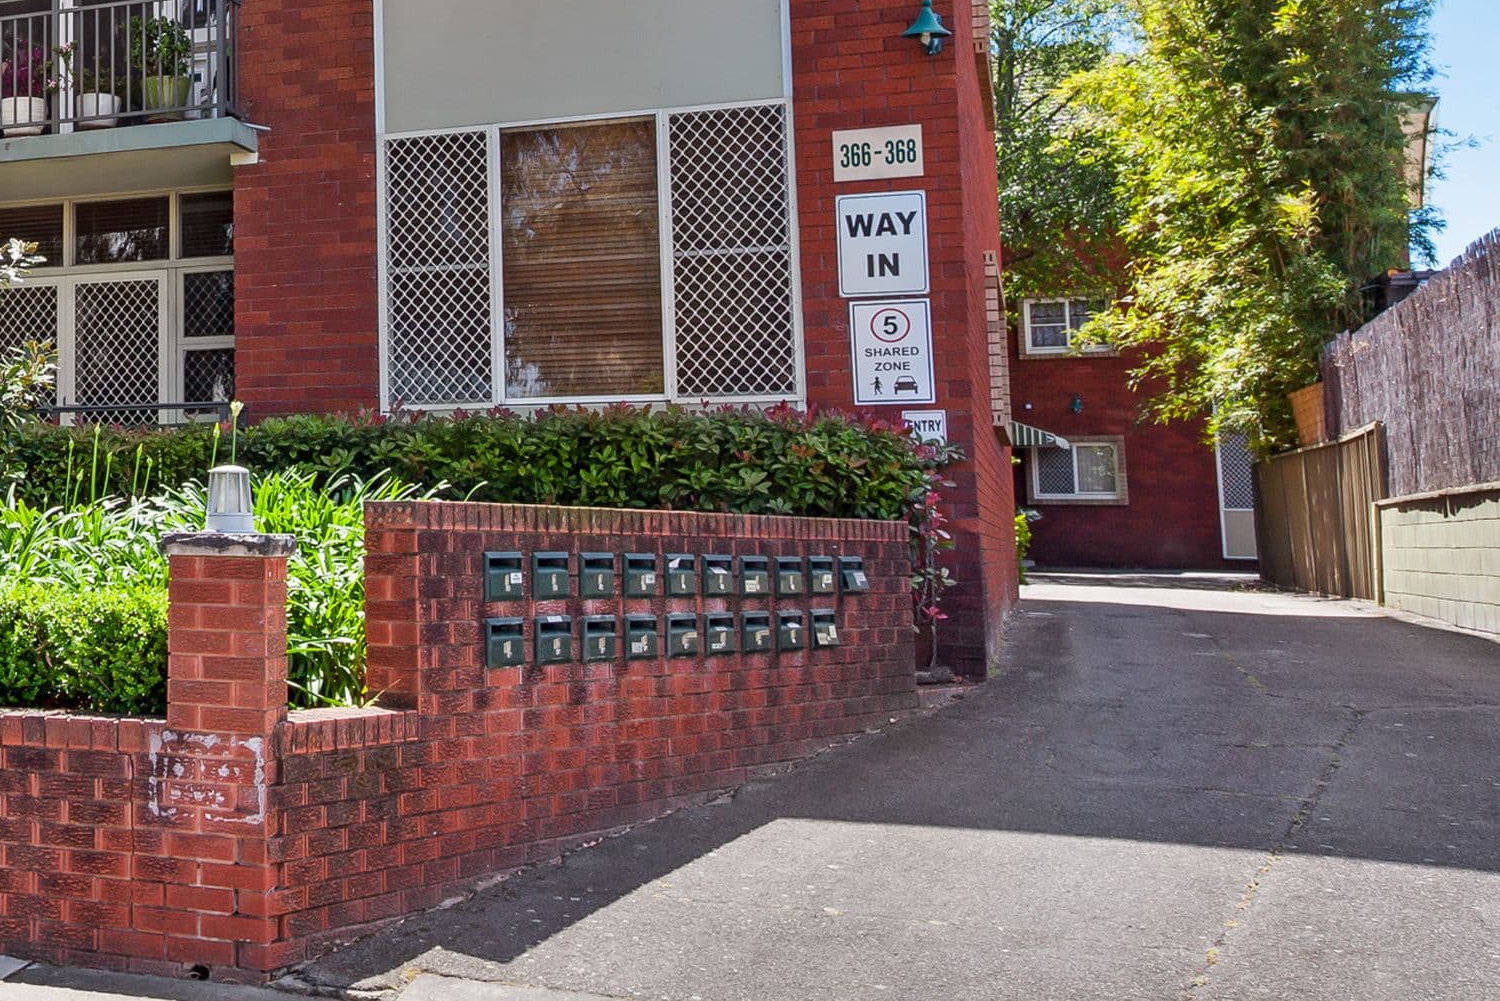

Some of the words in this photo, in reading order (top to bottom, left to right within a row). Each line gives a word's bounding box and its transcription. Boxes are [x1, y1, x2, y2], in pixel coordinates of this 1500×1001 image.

[845, 211, 917, 238] WAY
[866, 253, 900, 278] IN
[883, 315, 898, 335] 5
[864, 346, 920, 358] SHARED
[874, 361, 912, 372] ZONE
